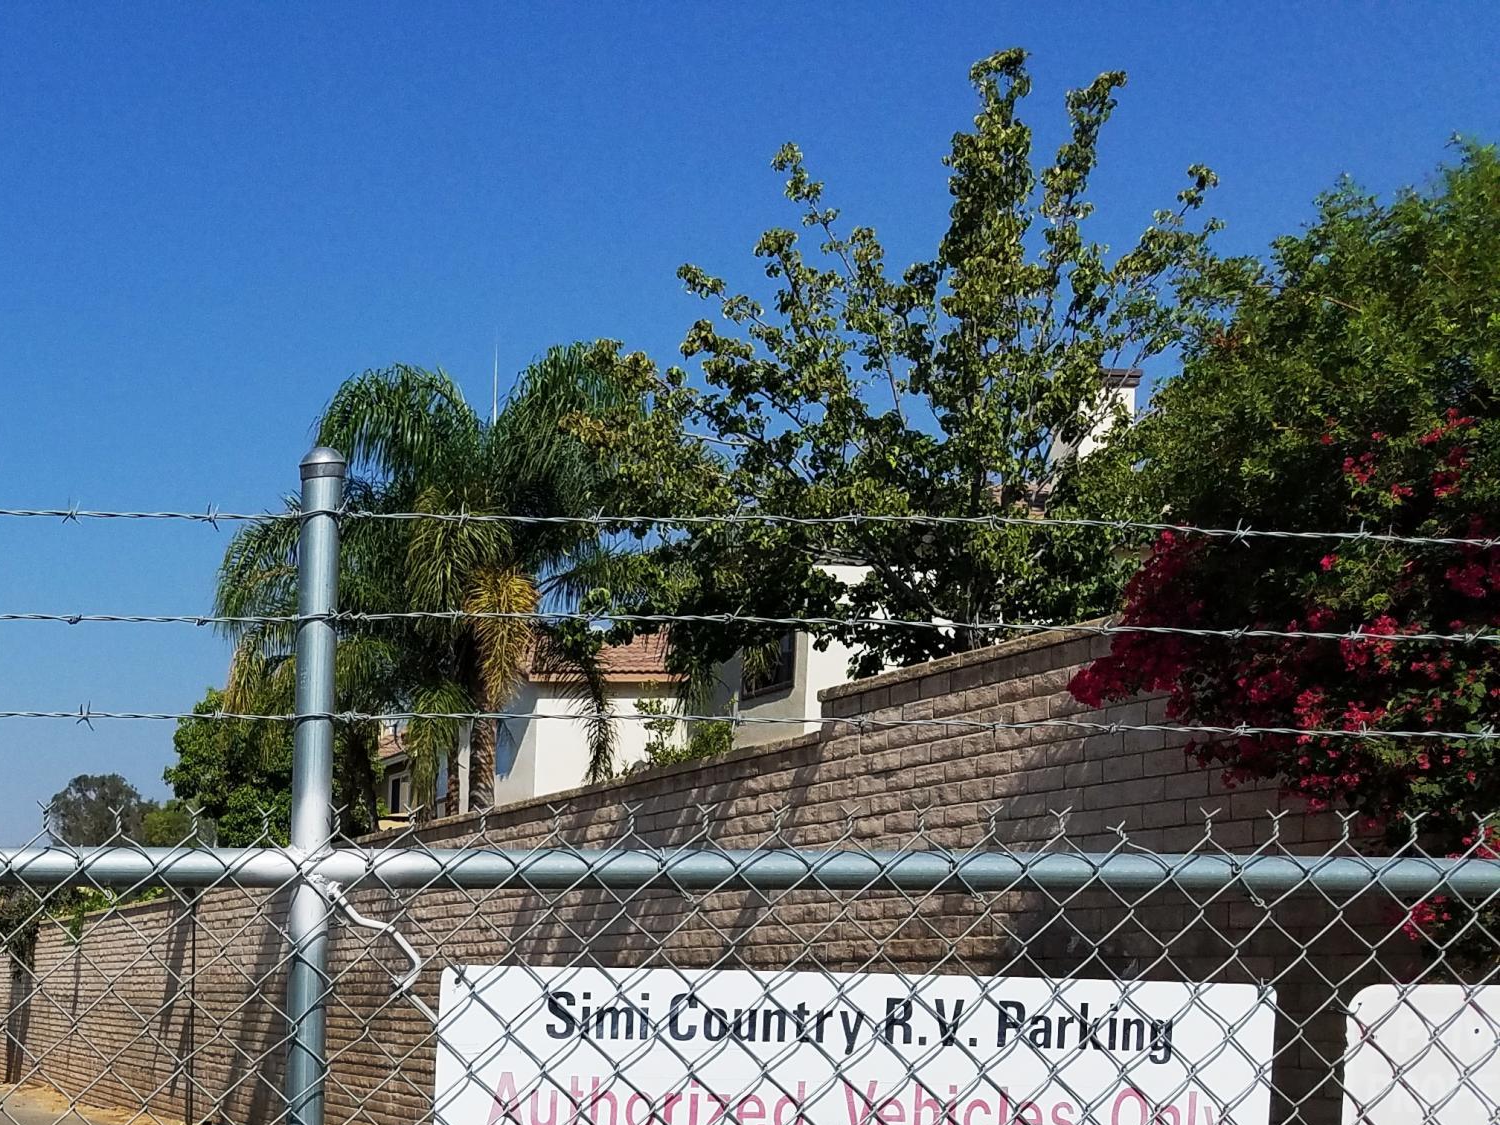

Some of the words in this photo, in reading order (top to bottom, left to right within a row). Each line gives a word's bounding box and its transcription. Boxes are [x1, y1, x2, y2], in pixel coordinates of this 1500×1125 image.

[546, 992, 650, 1040] Simi
[669, 993, 864, 1055] Country
[885, 997, 977, 1047] R.V.
[996, 1000, 1174, 1065] Parking
